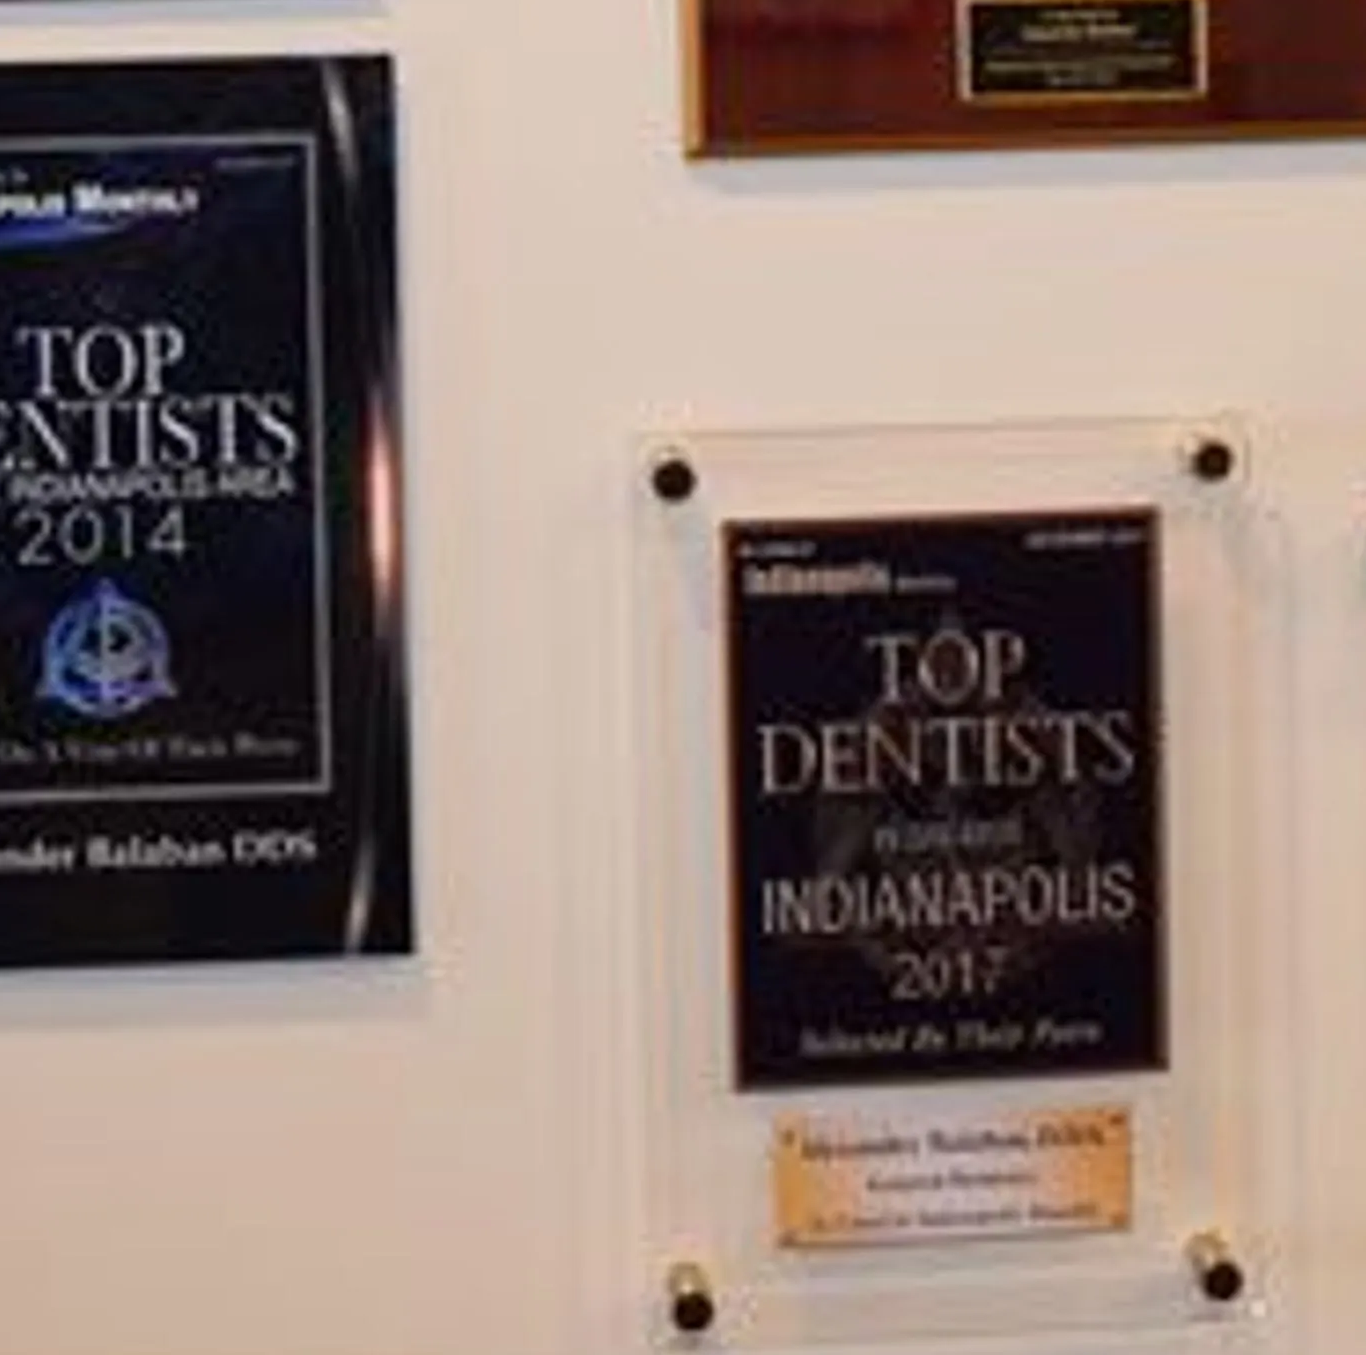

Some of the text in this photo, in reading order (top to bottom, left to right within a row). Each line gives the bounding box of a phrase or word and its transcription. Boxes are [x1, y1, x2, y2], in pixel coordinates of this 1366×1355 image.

[12, 323, 188, 399] TOP
[9, 468, 212, 504] INDIANAPOLIS
[217, 465, 299, 501] AREA
[15, 506, 189, 567] 2014
[863, 627, 1027, 706] TOP
[755, 710, 1137, 796] DENTISTS
[761, 861, 1138, 935] INDIANAPOLIS
[889, 947, 1013, 1002] 2017
